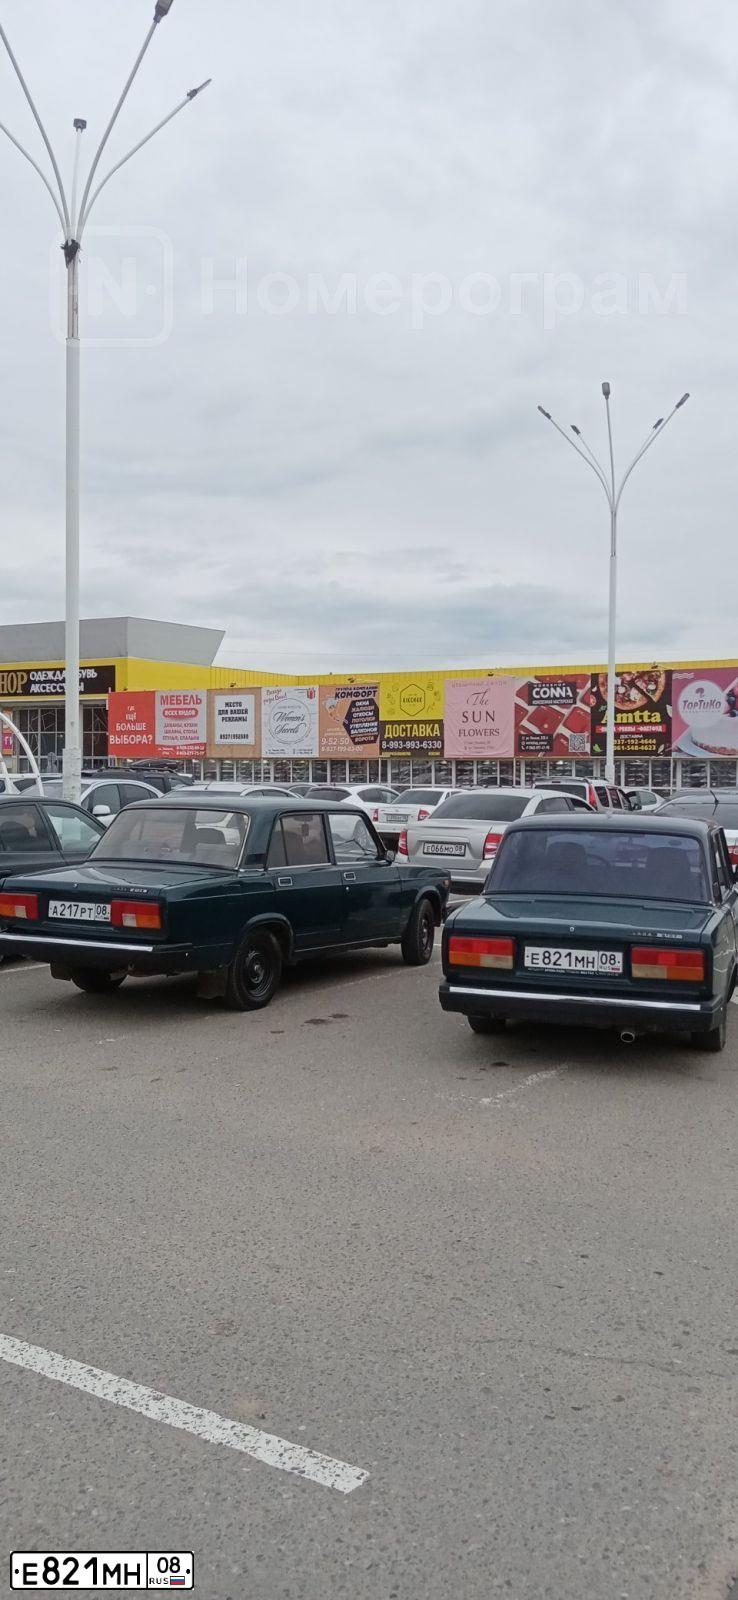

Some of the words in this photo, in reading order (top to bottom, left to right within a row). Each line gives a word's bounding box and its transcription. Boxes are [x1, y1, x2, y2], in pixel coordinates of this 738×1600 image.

[335, 690, 378, 699] КОМФОРТ
[532, 686, 573, 698] CONNA
[160, 694, 202, 706] МЕБЕЛЬ
[272, 711, 306, 722] Women's
[461, 710, 496, 723] SUN
[116, 722, 147, 731] БОЛЬШЕ
[384, 723, 441, 739] ДОСТАВКА
[458, 728, 500, 738] FLOWERS
[109, 734, 153, 745] ВЫБОРА?
[381, 740, 442, 749] 8-993-993-6330
[52, 903, 94, 918] А217РТ
[96, 905, 107, 915] 08
[530, 951, 595, 968] Е821МН
[600, 952, 617, 965] 08
